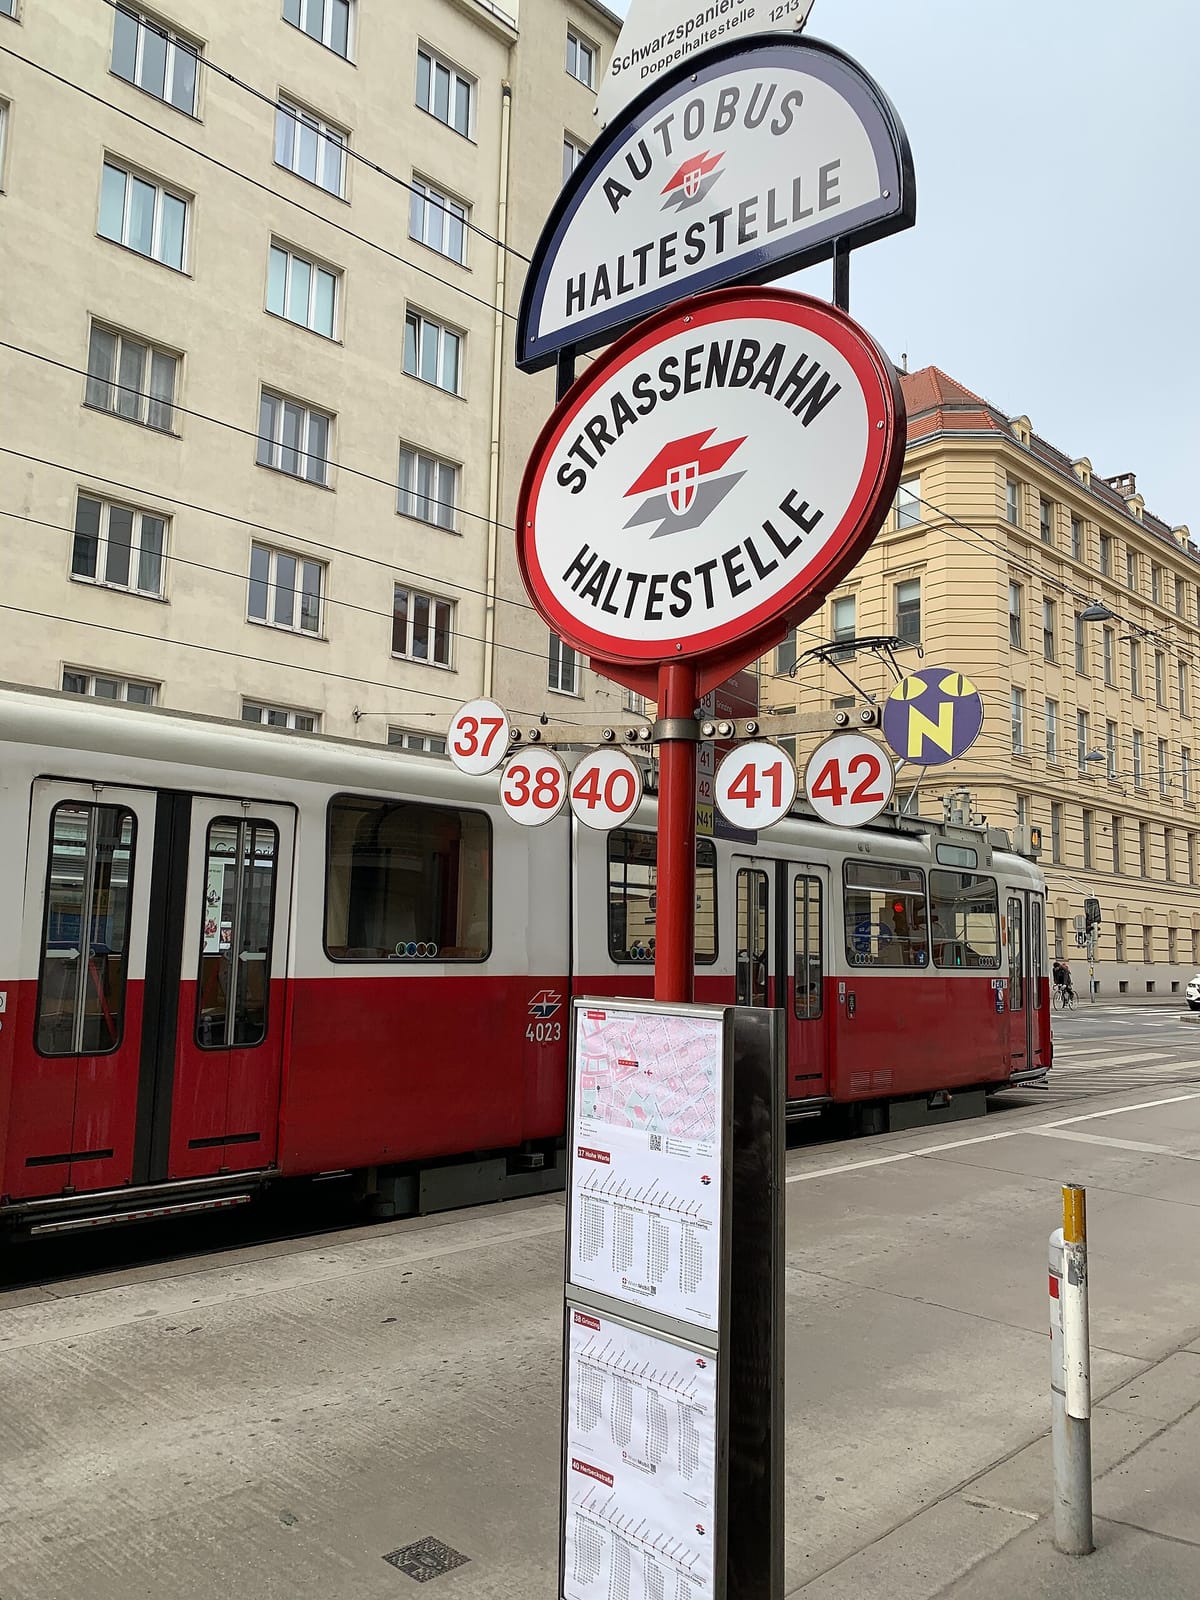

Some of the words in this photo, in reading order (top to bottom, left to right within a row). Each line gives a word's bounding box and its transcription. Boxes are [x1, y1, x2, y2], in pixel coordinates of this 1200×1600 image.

[640, 7, 755, 79] Doppelhaltestelle
[769, 0, 800, 23] 1213
[603, 83, 804, 214] AUTOBUS
[565, 158, 841, 318] HALTESTELLE
[556, 338, 842, 495] STRASSENBAHN
[562, 488, 825, 621] HALTESTELLE
[454, 716, 504, 757] 37
[907, 702, 955, 758] N
[700, 751, 710, 768] 41
[811, 753, 884, 806] 42
[504, 765, 560, 810] 38
[572, 767, 636, 813] 40
[699, 780, 710, 798] 42
[727, 761, 782, 809] 41
[697, 810, 713, 829] N41
[525, 1022, 561, 1042] 4023
